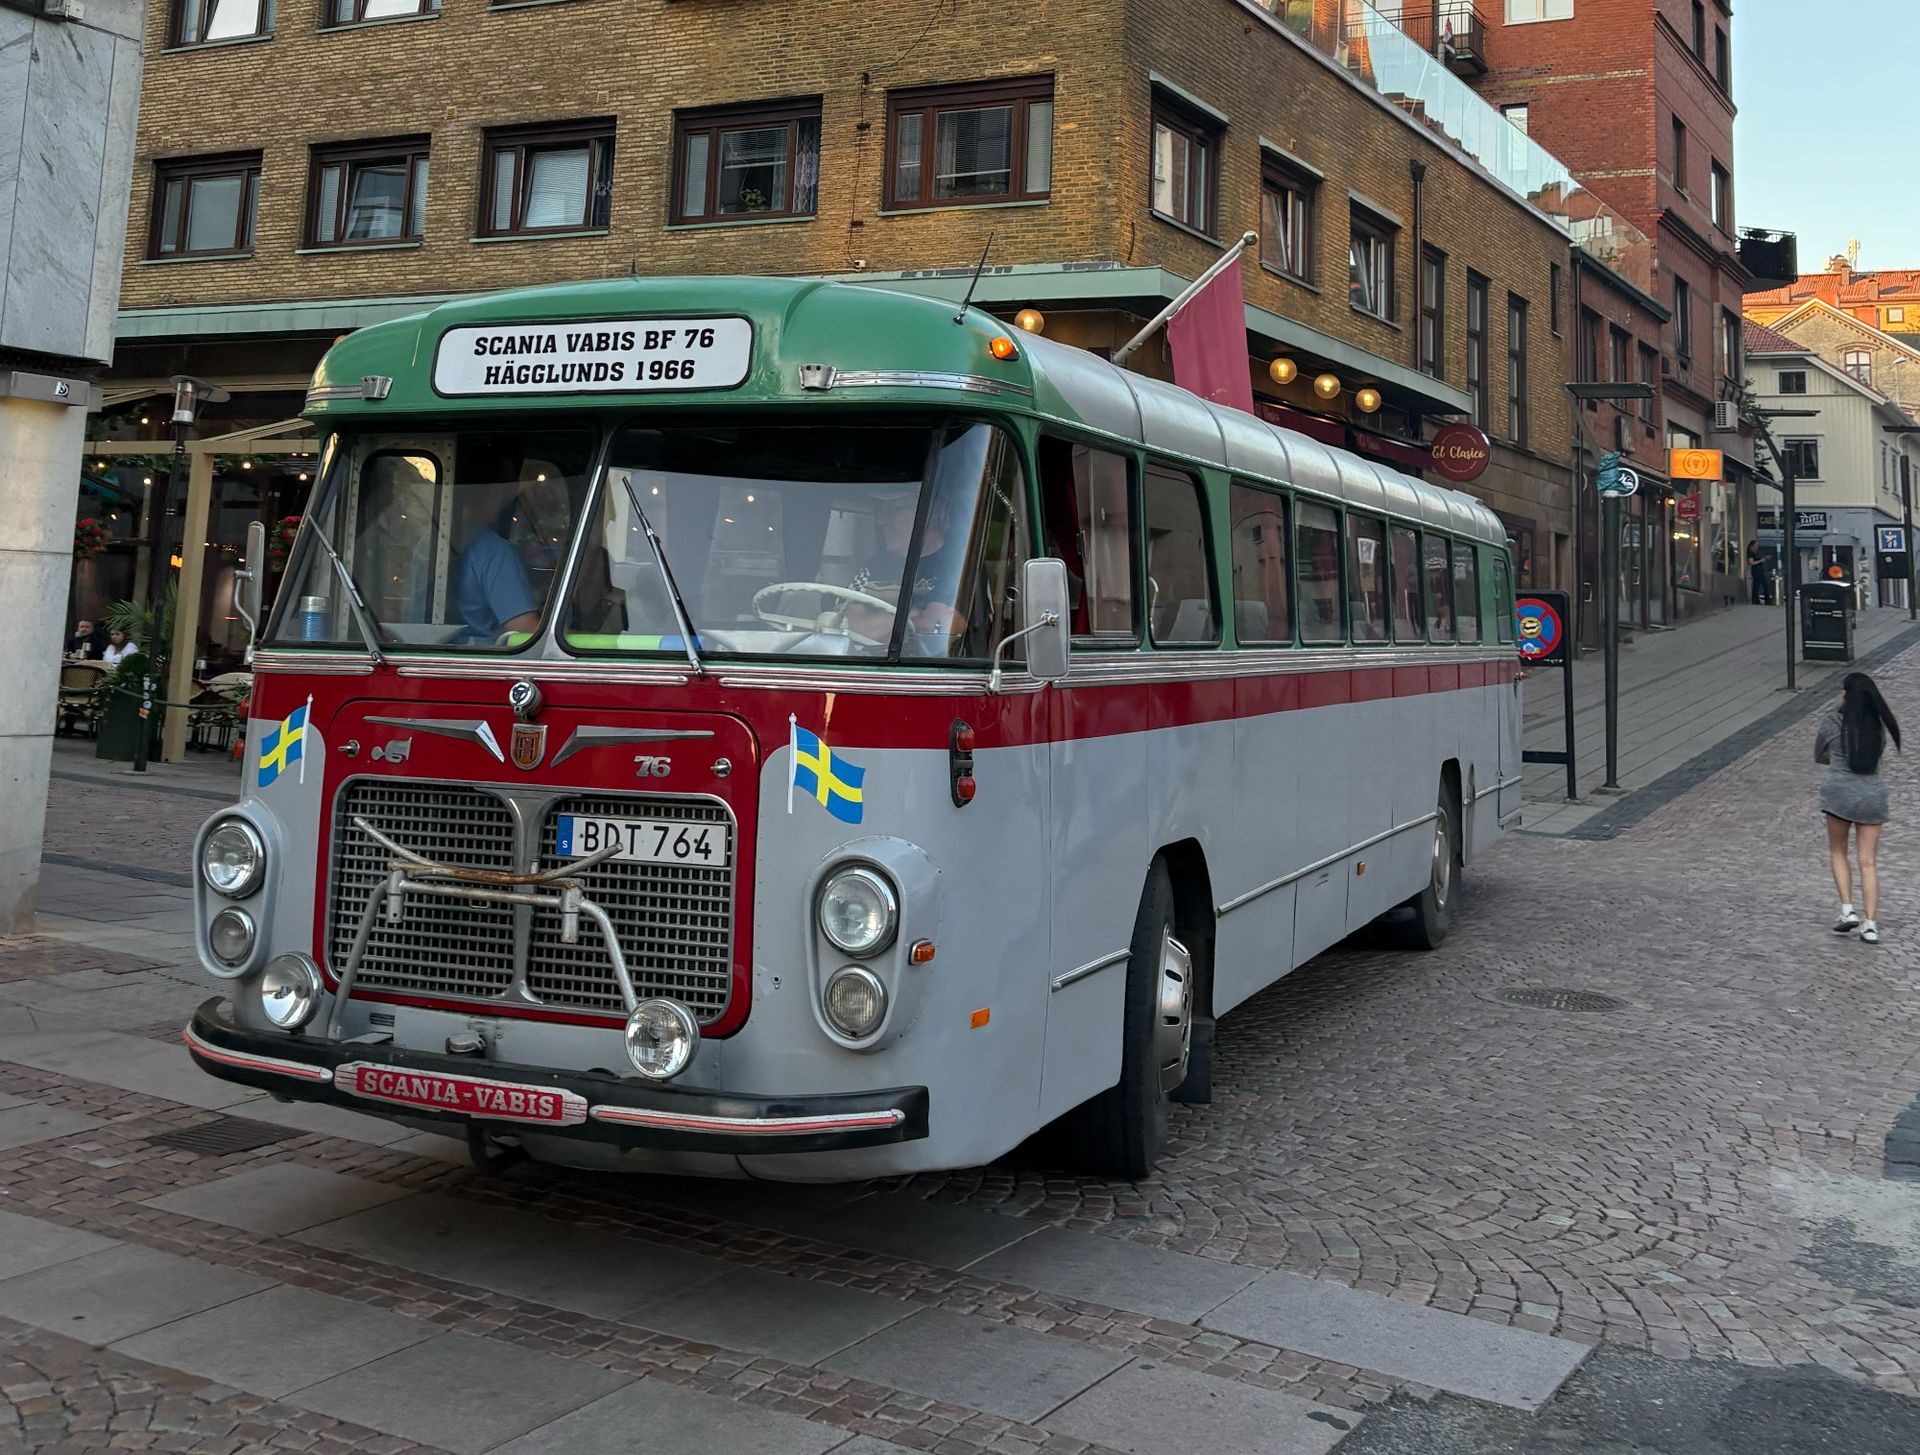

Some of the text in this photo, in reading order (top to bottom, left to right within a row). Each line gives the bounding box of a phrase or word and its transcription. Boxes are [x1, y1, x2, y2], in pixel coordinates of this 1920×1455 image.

[474, 328, 715, 356] SCANIA VABIS BF 76
[484, 359, 696, 385] HÄGGLUNDS 1966
[1431, 445, 1486, 460] El Clasico
[633, 755, 671, 778] 76
[562, 839, 569, 849] S
[583, 821, 712, 861] BDT 764
[363, 1070, 555, 1118] SCANIA-VABIS
